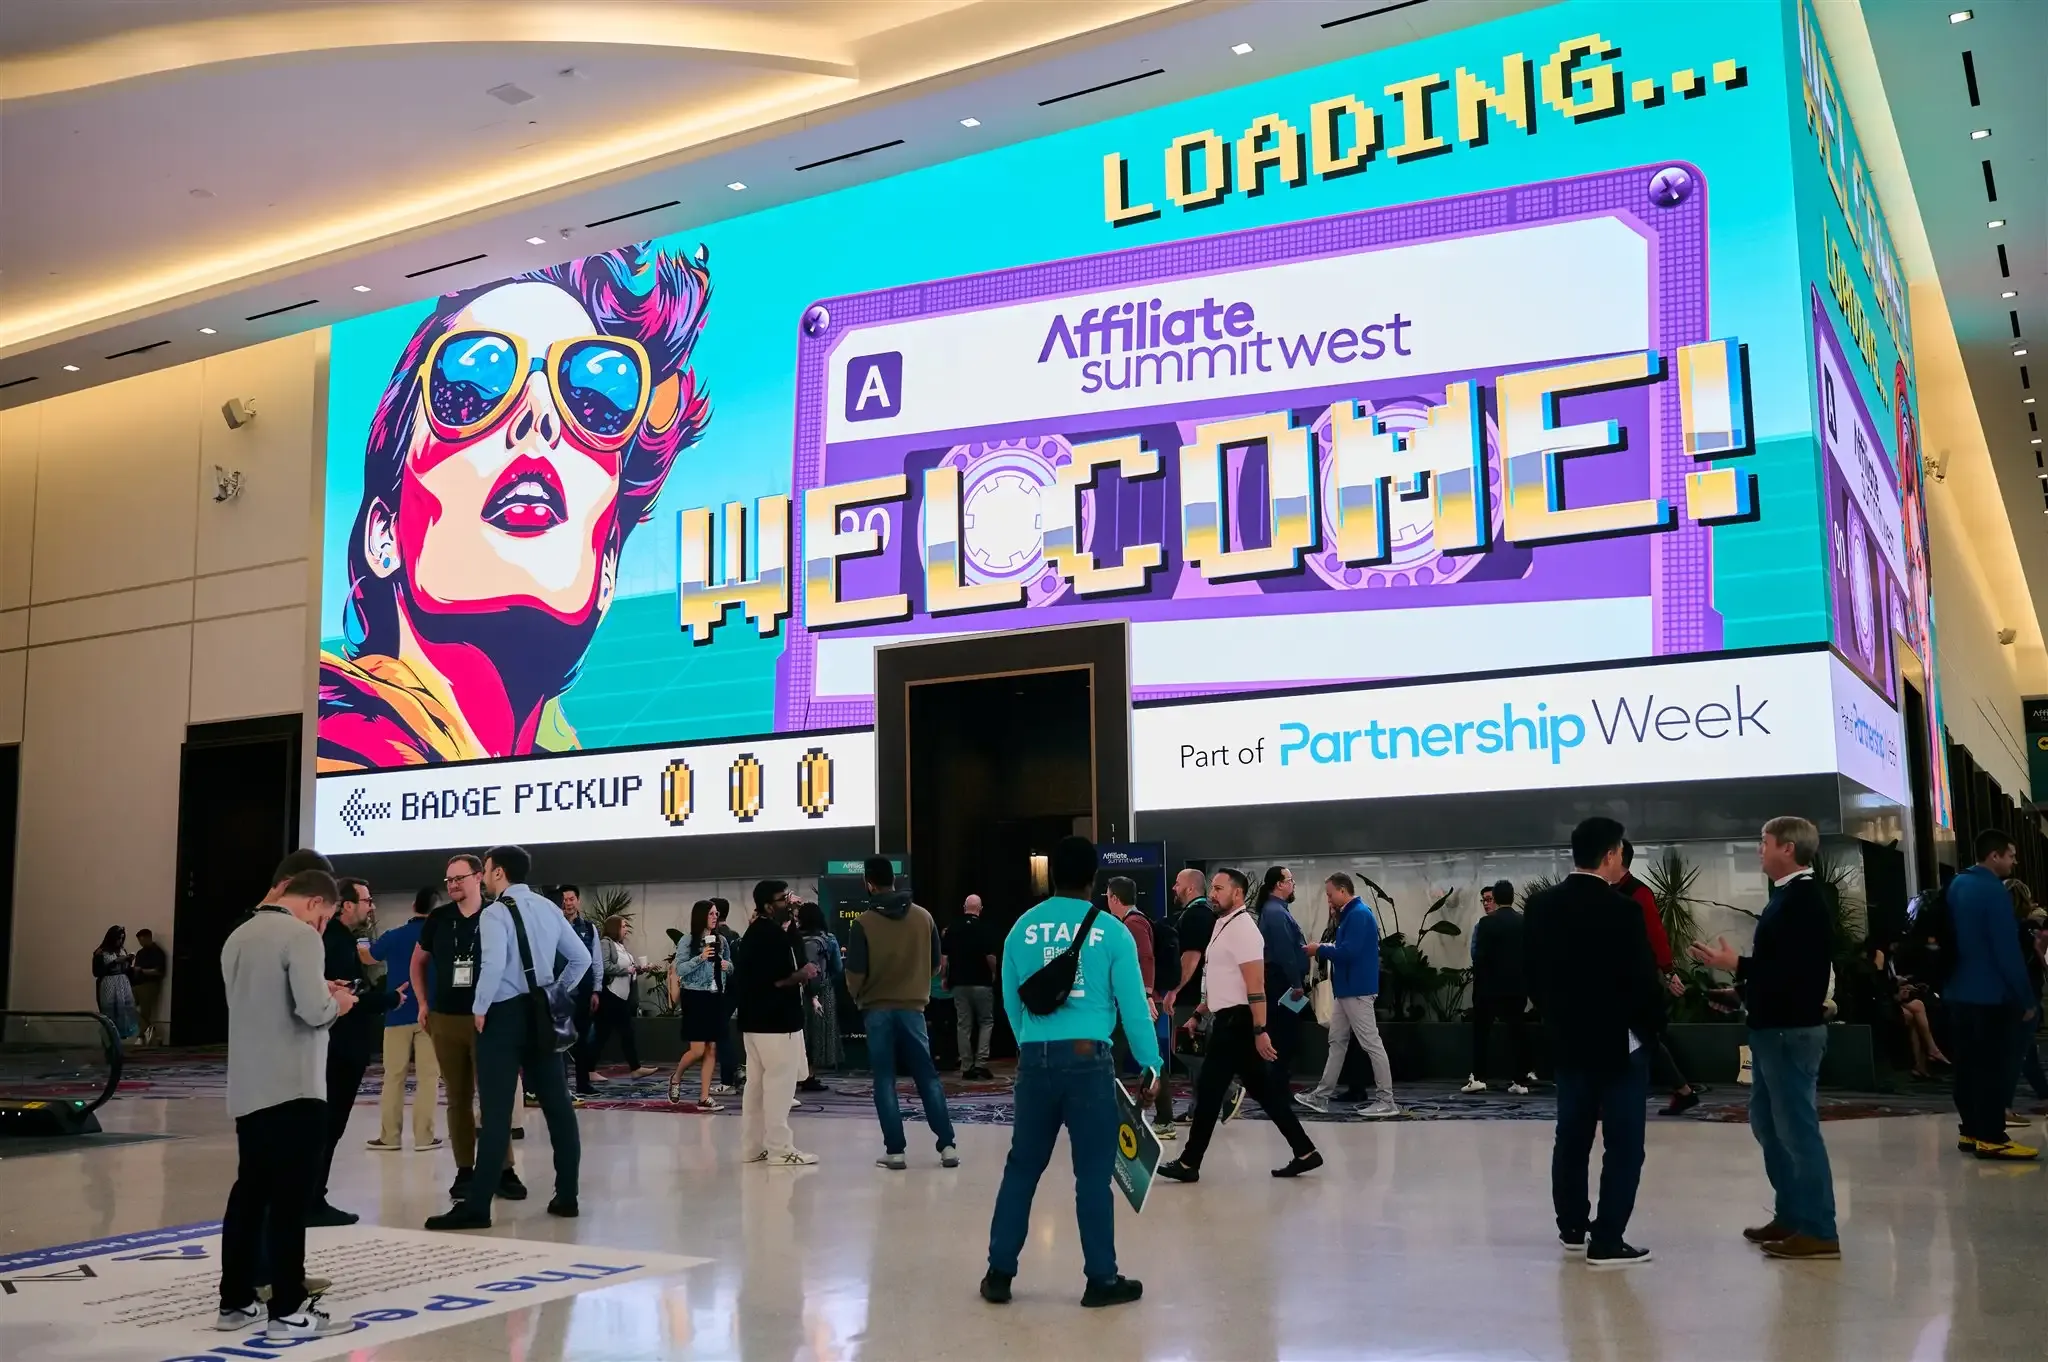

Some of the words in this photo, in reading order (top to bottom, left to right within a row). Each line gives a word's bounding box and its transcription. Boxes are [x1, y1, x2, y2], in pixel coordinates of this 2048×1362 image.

[1104, 33, 1747, 228] LOADING...
[1038, 298, 1255, 363] Affiliate
[855, 365, 892, 411] A
[677, 336, 1760, 647] WELCOME!
[1180, 743, 1229, 769] Part
[1237, 738, 1265, 765] of
[1279, 702, 1586, 766] Partnership
[1591, 684, 1772, 745] Week
[401, 785, 501, 821] BADGE
[514, 775, 643, 814] PICKUP
[474, 1262, 645, 1293] The
